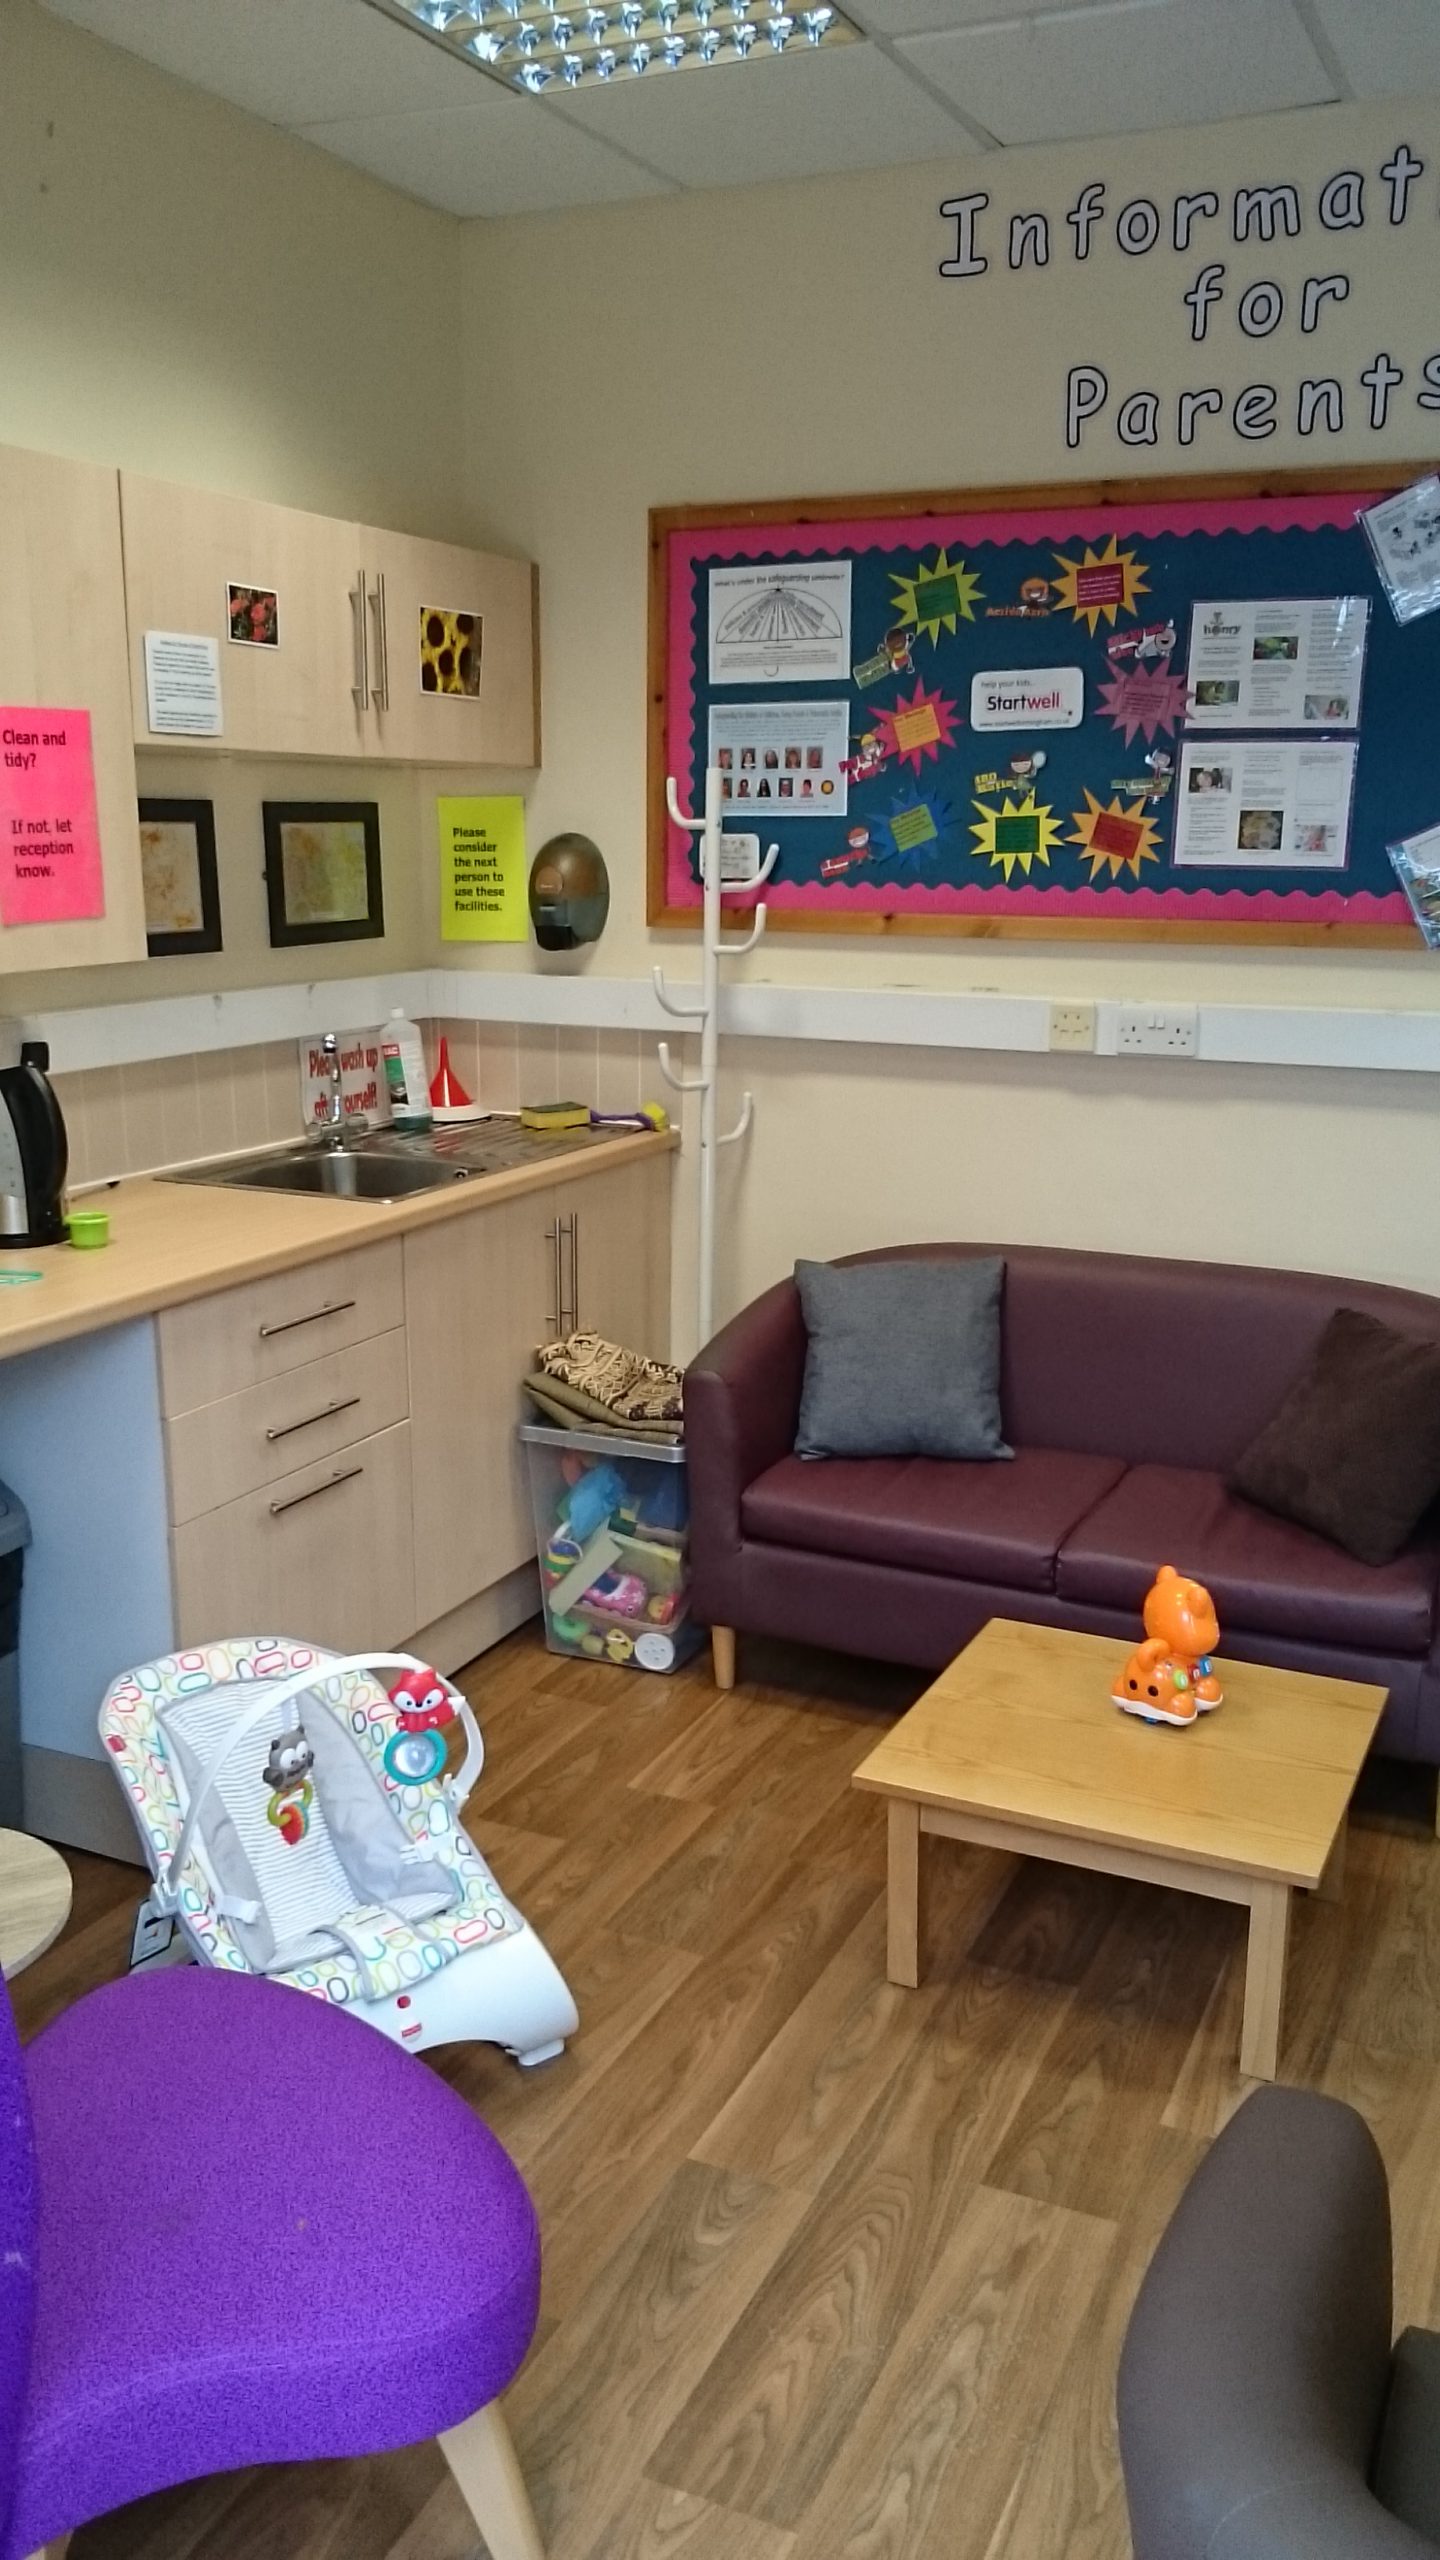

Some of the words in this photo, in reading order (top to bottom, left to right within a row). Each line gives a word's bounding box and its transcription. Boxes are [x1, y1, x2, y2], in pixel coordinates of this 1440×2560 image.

[939, 144, 1440, 278] Informat
[1183, 264, 1350, 341] for
[998, 680, 1014, 690] your
[987, 691, 1060, 711] Startwell
[2, 729, 39, 746] Clean
[42, 730, 66, 746] and
[4, 752, 37, 771] tidy?
[11, 819, 24, 834] If
[56, 818, 73, 834] let
[452, 828, 487, 838] Please
[13, 841, 74, 858] reception
[453, 842, 497, 853] consider
[454, 856, 471, 868] the
[474, 857, 497, 868] next
[16, 863, 56, 879] know.
[454, 873, 490, 885] person
[493, 872, 504, 882] to
[454, 887, 473, 897] use
[476, 886, 505, 897] these
[454, 900, 503, 912] facilities.
[341, 1043, 365, 1072] wash
[366, 1048, 379, 1072] up
